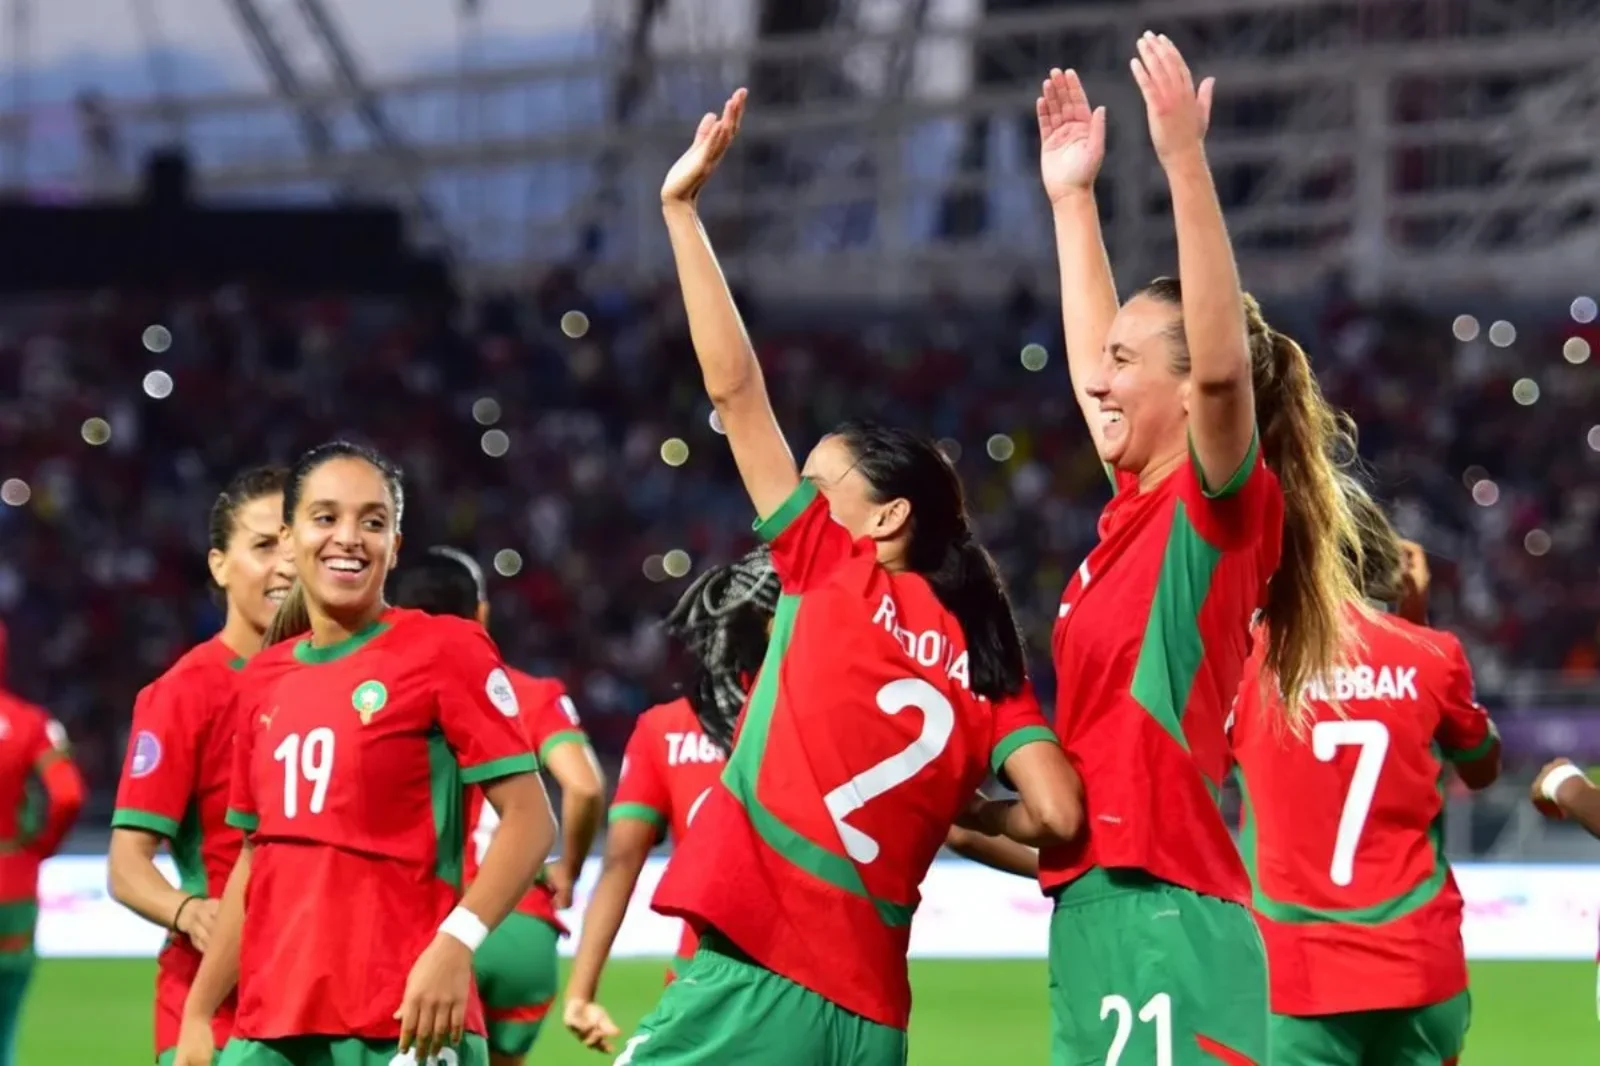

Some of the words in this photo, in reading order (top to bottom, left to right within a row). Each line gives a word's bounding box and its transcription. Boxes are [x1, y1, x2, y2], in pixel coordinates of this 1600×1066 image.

[274, 727, 335, 819] 19
[824, 678, 954, 864] 2
[1313, 720, 1389, 886] 7
[1100, 992, 1172, 1066] 21
